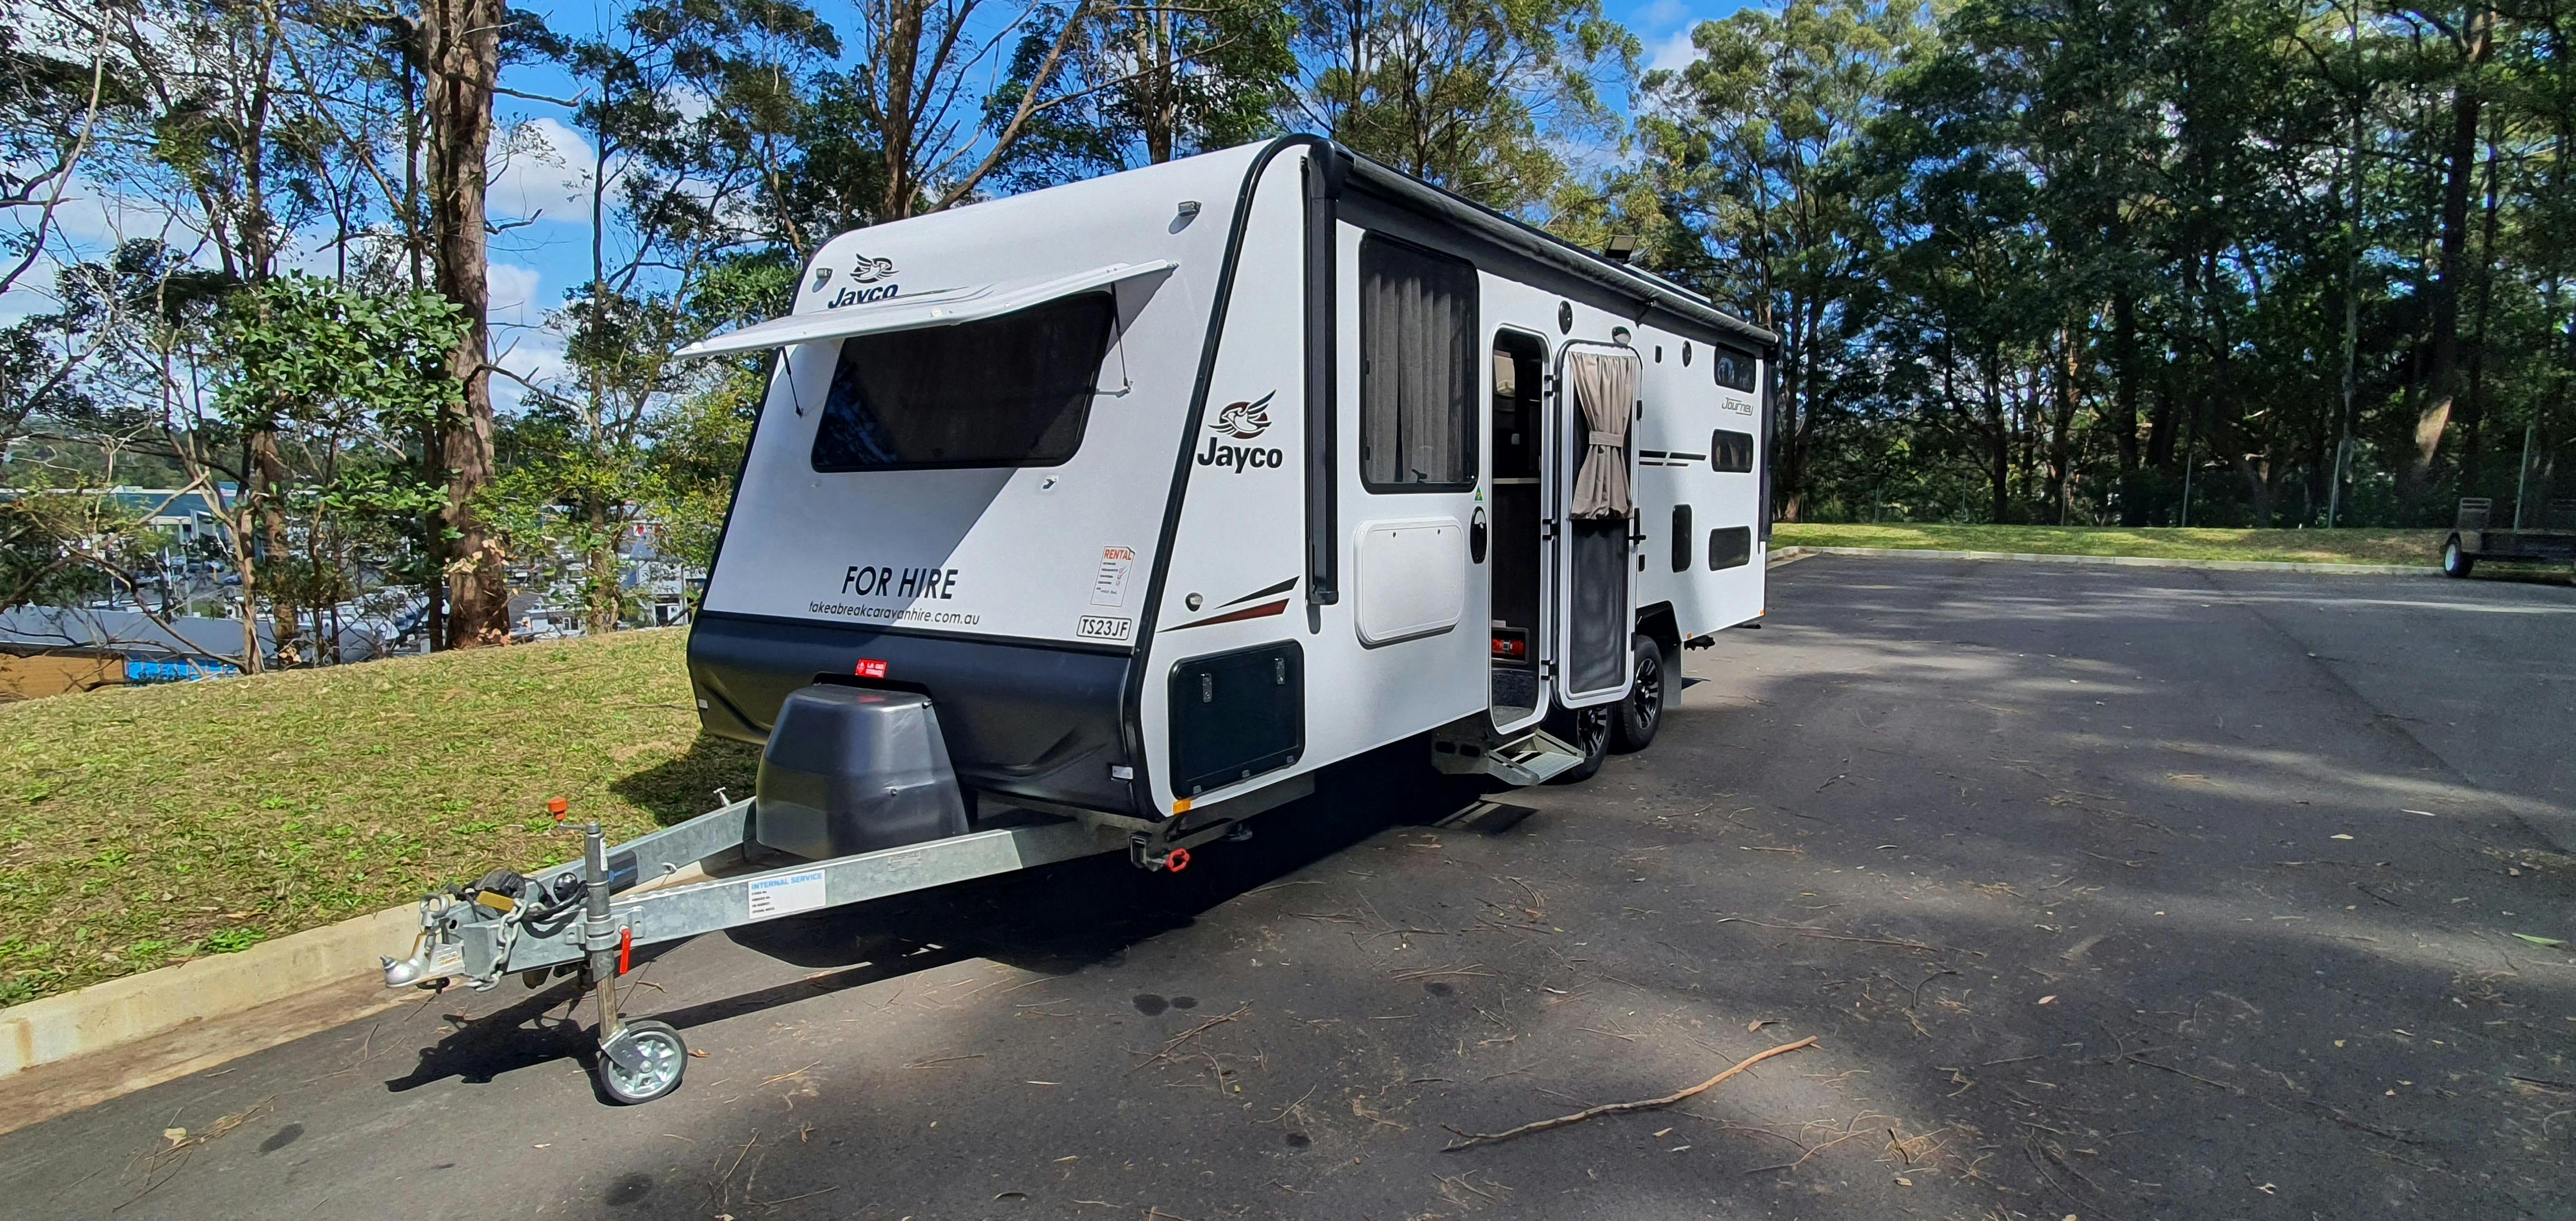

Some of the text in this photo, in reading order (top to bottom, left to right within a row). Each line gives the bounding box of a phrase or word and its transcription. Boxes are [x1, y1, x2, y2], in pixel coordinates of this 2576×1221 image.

[828, 284, 898, 309] Jayco
[1722, 397, 1754, 416] Journey
[1197, 437, 1282, 474] Jayco
[1104, 549, 1131, 560] RENTAL
[841, 566, 959, 599] FOR HIRE
[809, 600, 980, 625] takeabreakcaravanhire.com.au
[1082, 619, 1128, 637] TS23JF
[751, 873, 822, 890] INTERNAL SERVICE
